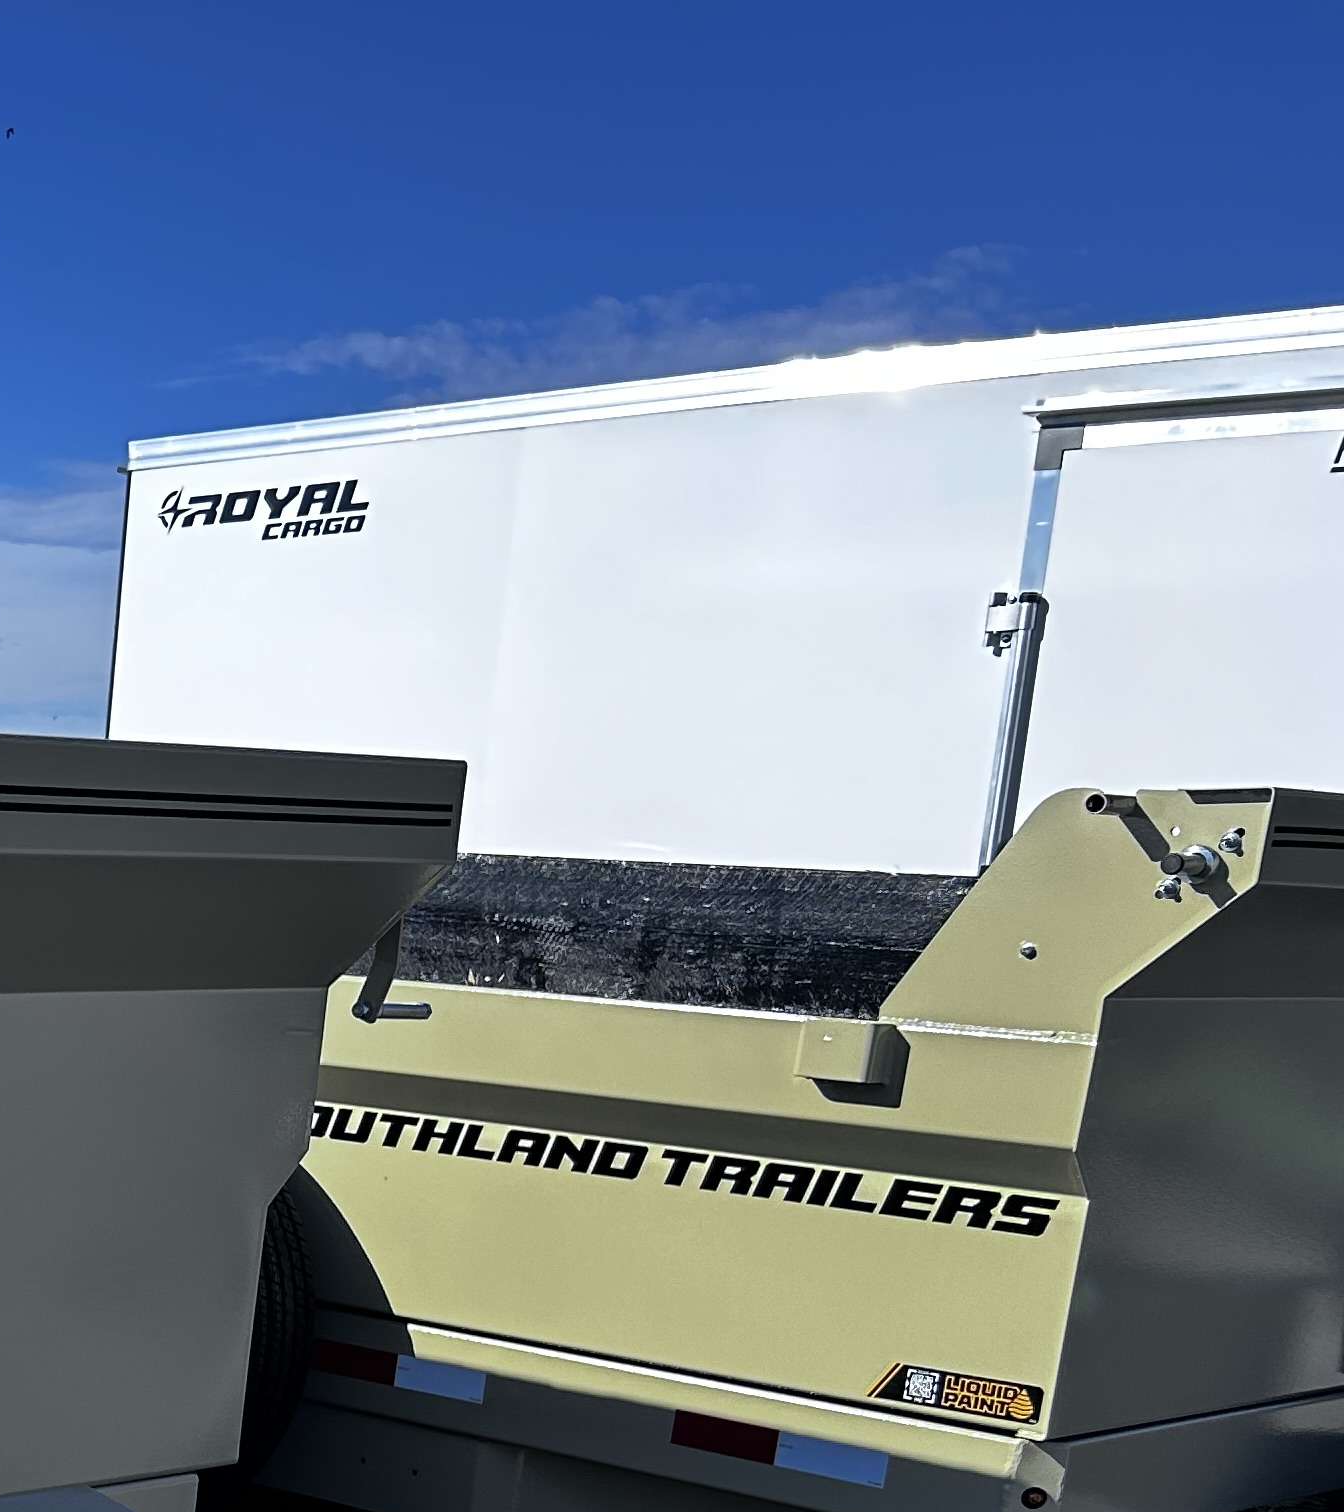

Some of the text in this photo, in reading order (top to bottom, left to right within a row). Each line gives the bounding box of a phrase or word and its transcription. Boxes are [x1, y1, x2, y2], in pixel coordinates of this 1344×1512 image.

[181, 479, 370, 528] ROYAL
[261, 515, 367, 541] CARGO
[661, 1149, 1060, 1237] TRAILERS
[946, 1375, 1020, 1402] LIQUID
[941, 1391, 1010, 1417] PAINT
